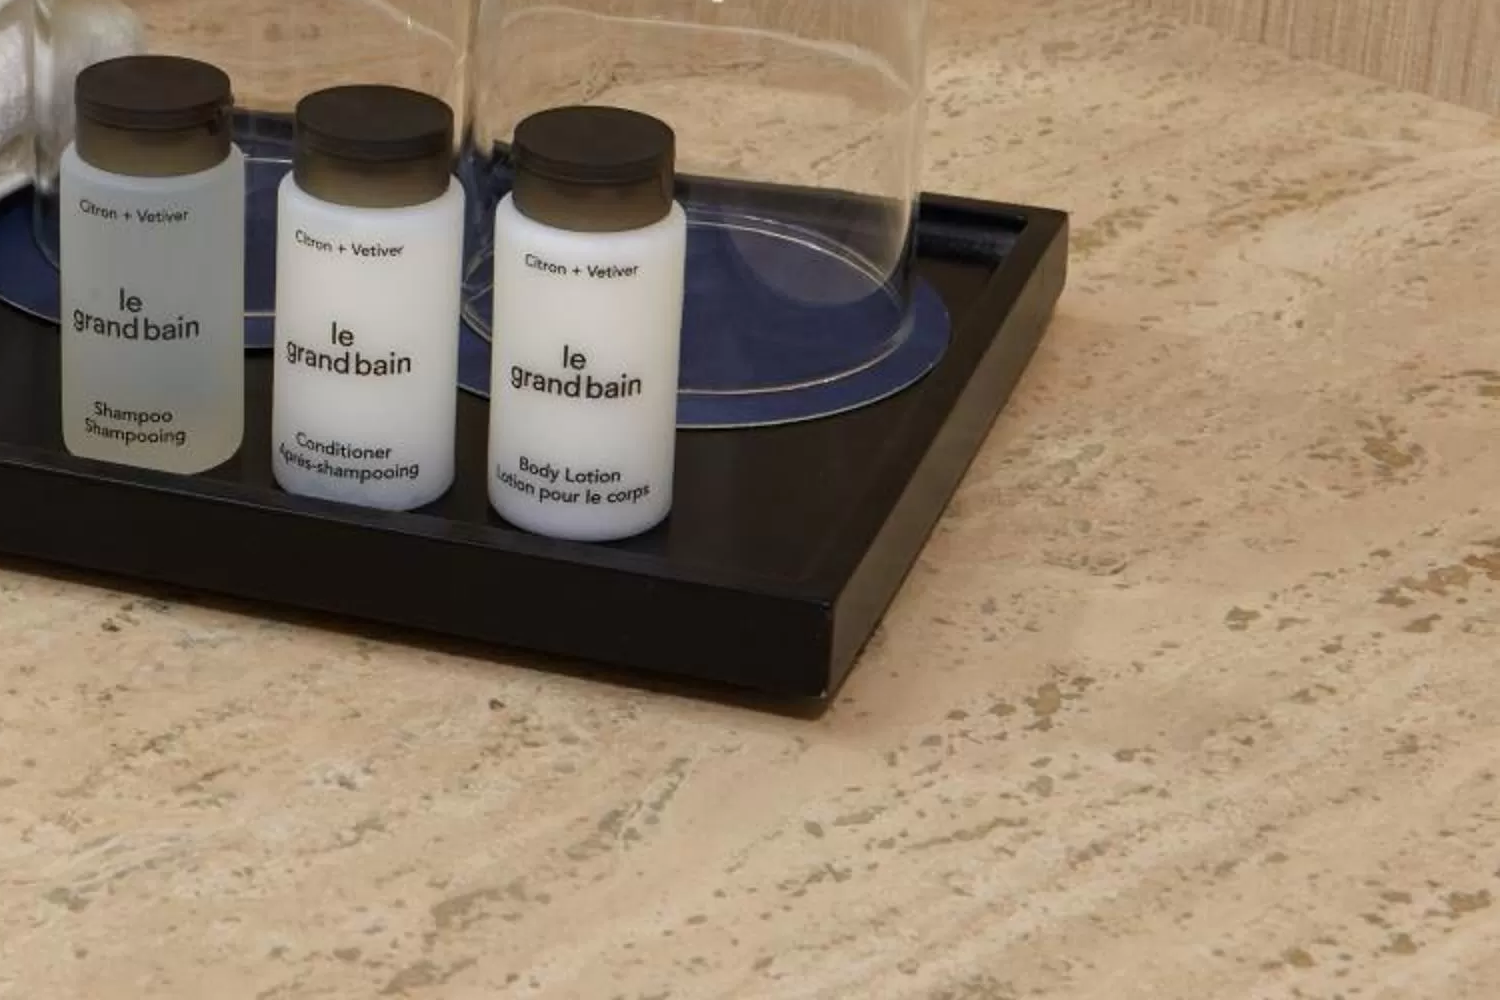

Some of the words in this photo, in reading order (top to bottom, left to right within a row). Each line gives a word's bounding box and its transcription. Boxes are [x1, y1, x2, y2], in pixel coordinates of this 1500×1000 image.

[79, 199, 118, 221] Citron
[136, 206, 189, 223] Vetiver
[351, 242, 404, 257] Vetiver
[525, 253, 567, 276] Citron
[587, 264, 639, 279] Vetiver
[119, 287, 143, 313] le
[73, 308, 138, 340] grand
[144, 316, 200, 341] bain
[331, 321, 354, 347] le
[286, 340, 350, 375] grand
[355, 352, 412, 376] bain
[563, 344, 586, 370] le
[511, 365, 581, 398] grand
[586, 373, 642, 399] bain
[94, 401, 173, 426] Shampoo
[85, 417, 187, 446] Shampooing
[295, 431, 393, 460] Conditioner
[519, 455, 560, 484] Body
[565, 467, 621, 484] Lotion
[497, 464, 535, 496] Lotion
[539, 486, 580, 503] pour
[586, 489, 601, 505] le
[607, 484, 650, 505] corps
